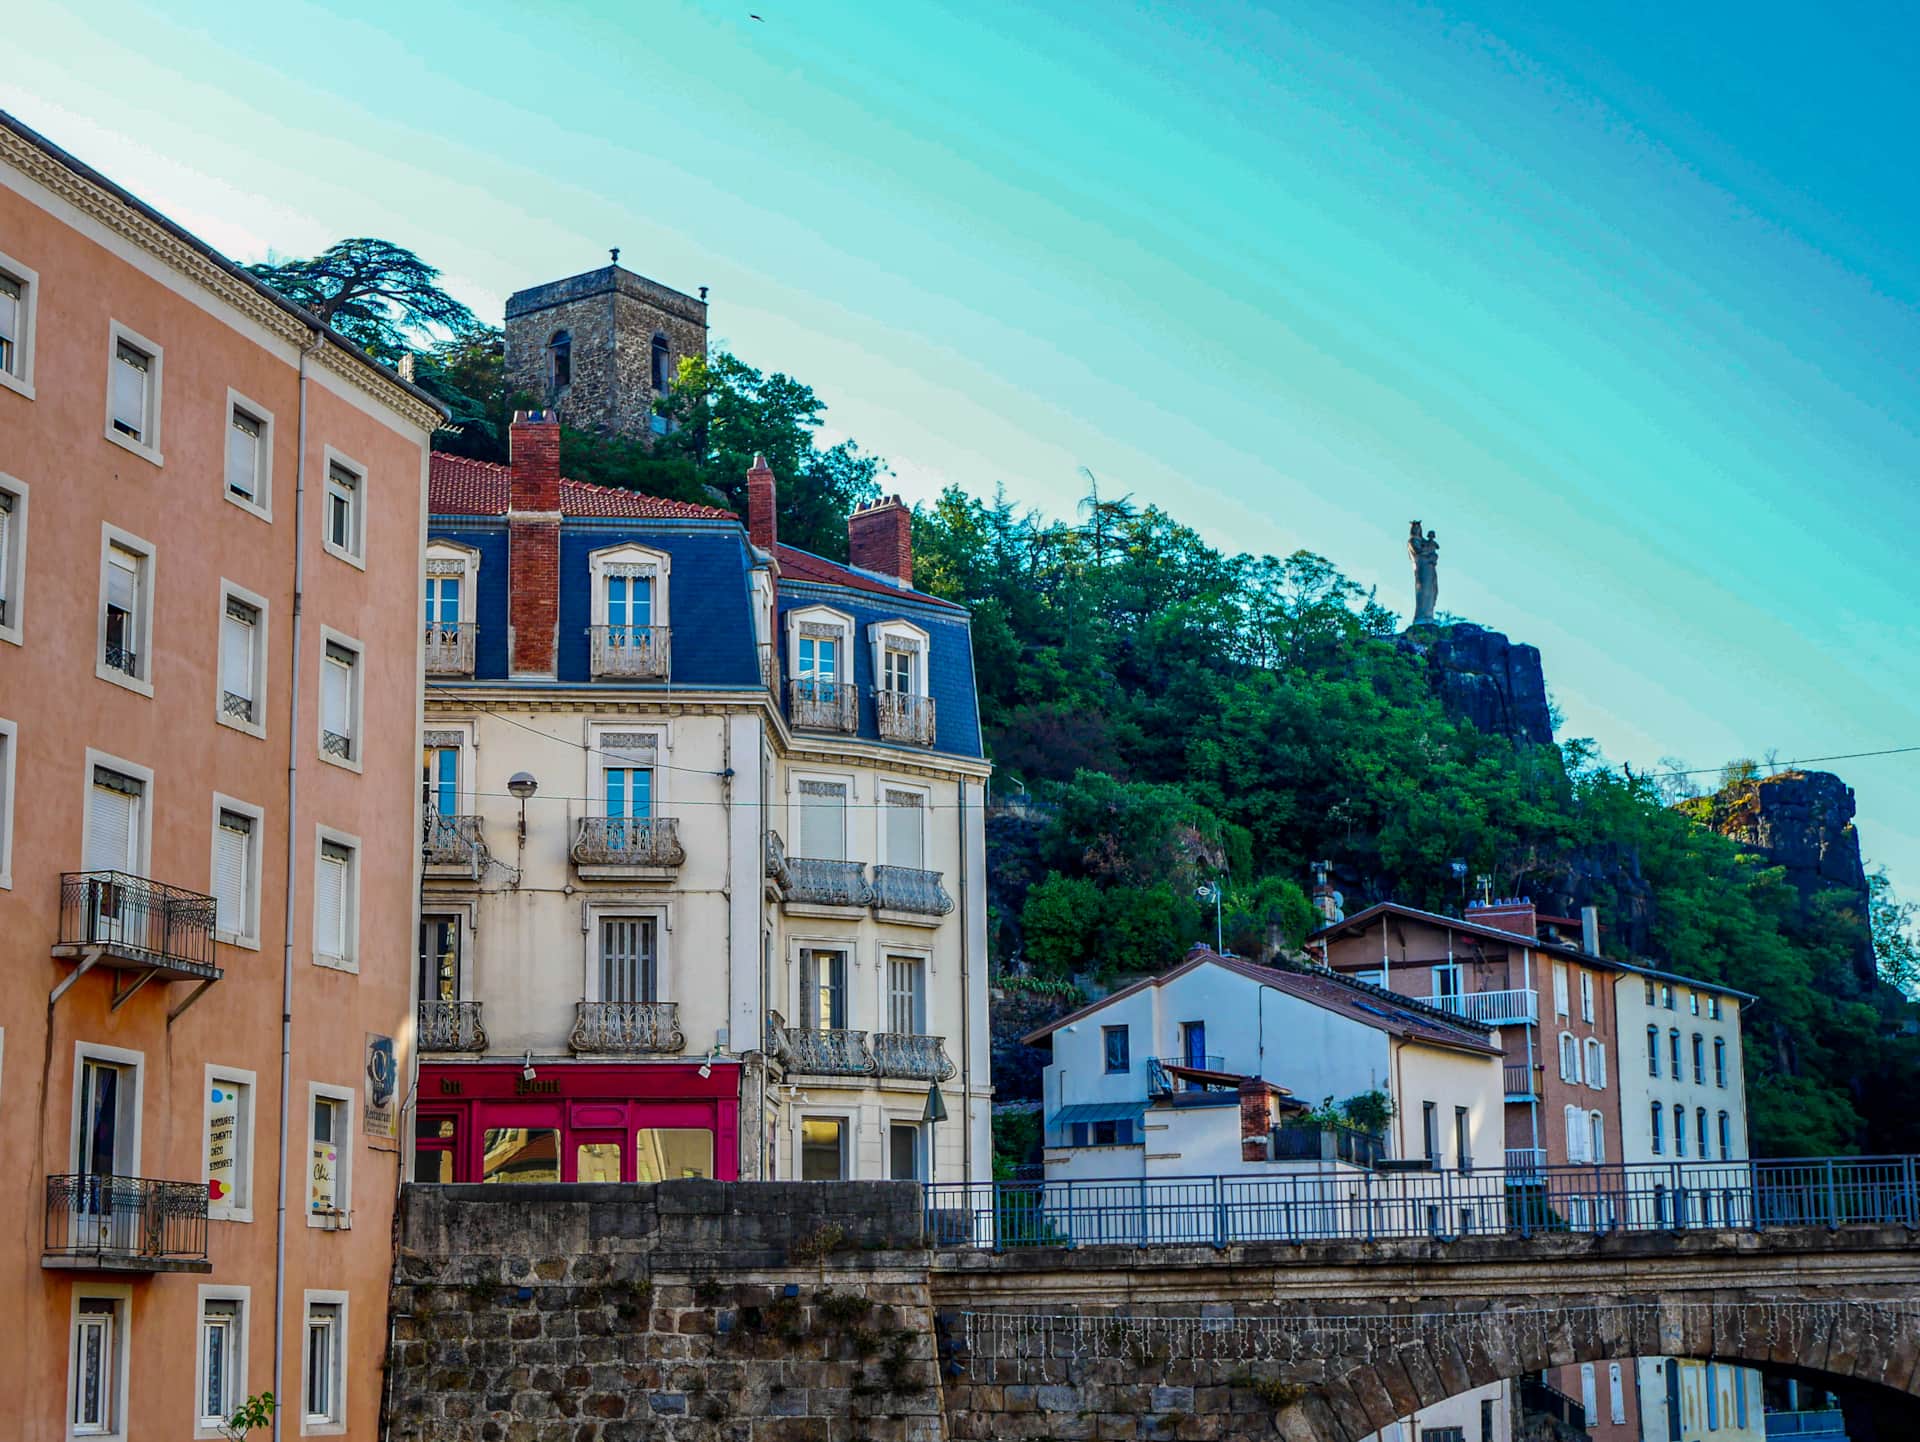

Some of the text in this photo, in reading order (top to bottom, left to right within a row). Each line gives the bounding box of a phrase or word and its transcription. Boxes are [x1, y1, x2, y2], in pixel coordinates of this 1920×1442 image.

[440, 1074, 561, 1095] du Pont
[365, 1105, 391, 1122] Restaurant
